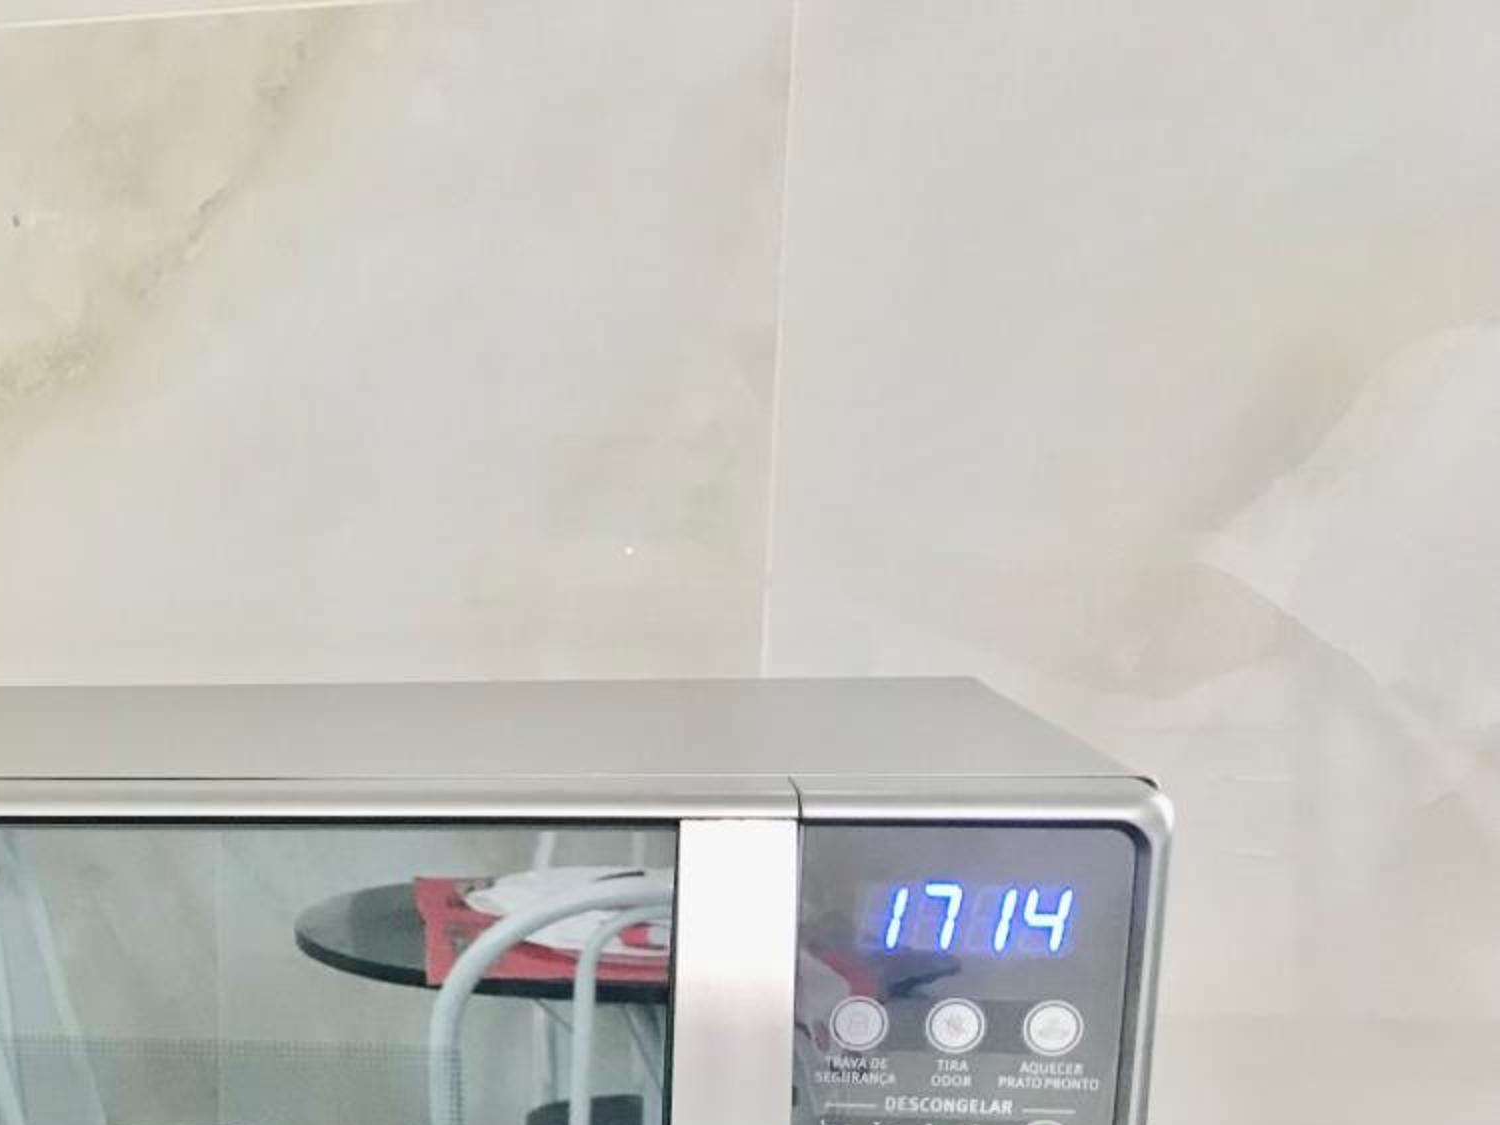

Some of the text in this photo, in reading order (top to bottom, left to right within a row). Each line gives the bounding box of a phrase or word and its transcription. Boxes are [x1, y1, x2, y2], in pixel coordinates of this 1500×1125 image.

[870, 1057, 888, 1070] DE
[937, 1059, 969, 1072] TIRA
[1019, 1061, 1083, 1075] AQUECER
[931, 1074, 972, 1087] ODOR
[998, 1076, 1100, 1091] PRATO PRONTO
[885, 1095, 1013, 1115] DESCONGELAR
